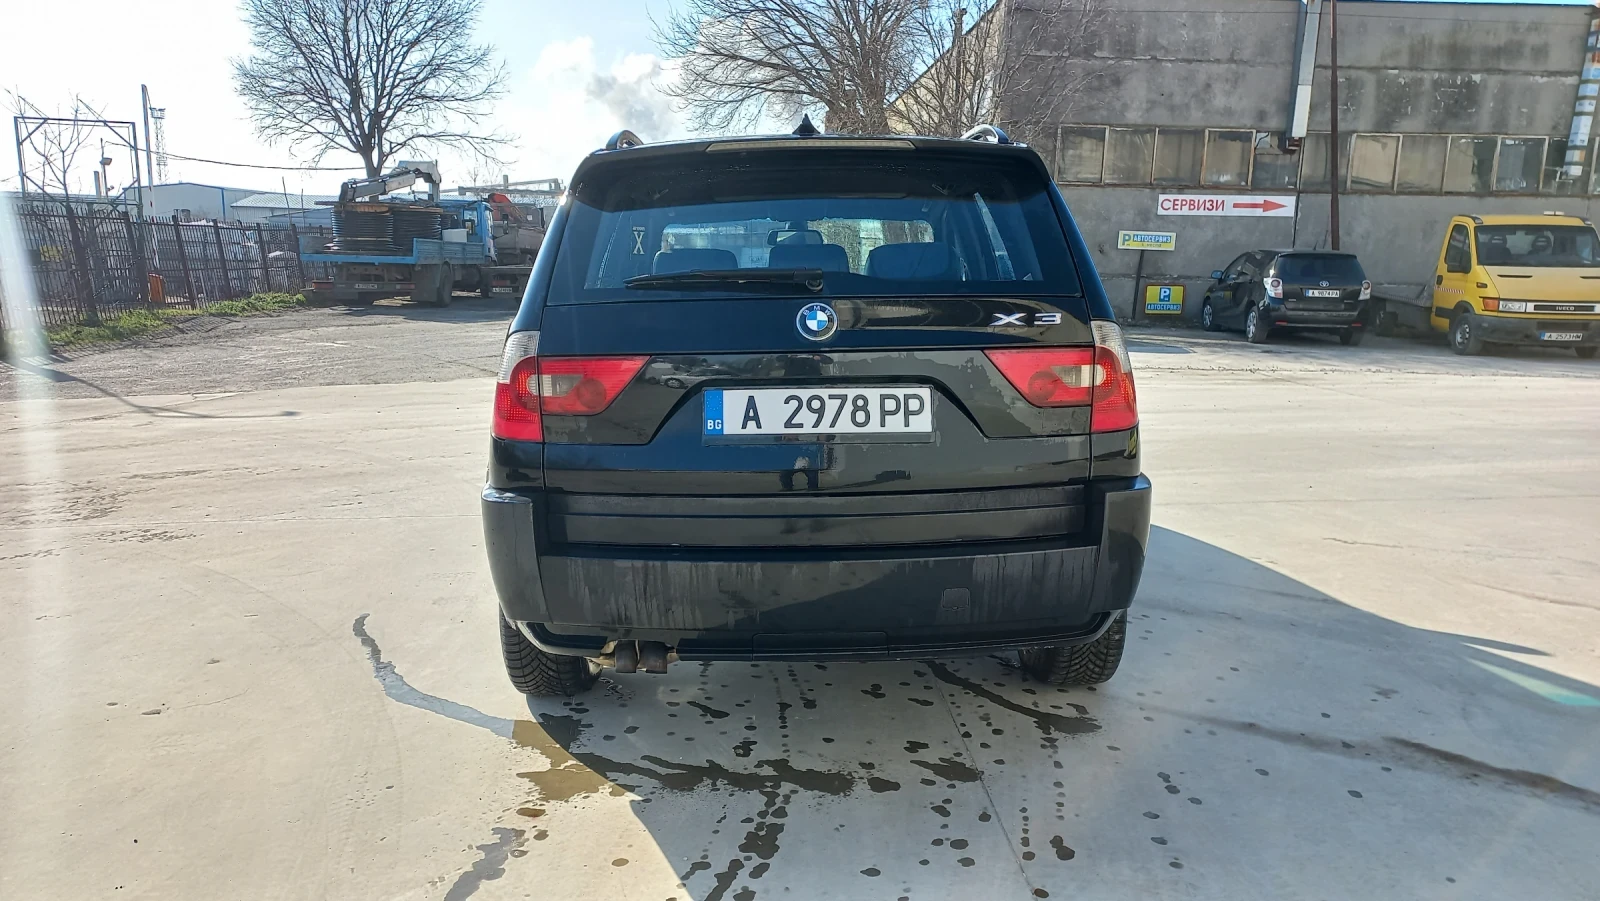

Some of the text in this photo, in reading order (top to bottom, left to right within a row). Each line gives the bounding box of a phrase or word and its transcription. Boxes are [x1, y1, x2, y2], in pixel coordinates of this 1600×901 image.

[1160, 198, 1225, 212] СЕРВИЗИ
[1133, 234, 1171, 243] АВТОСЕРВИЗ
[1160, 288, 1170, 300] P
[802, 305, 832, 316] BMW
[741, 395, 762, 430] A
[707, 419, 722, 430] BG
